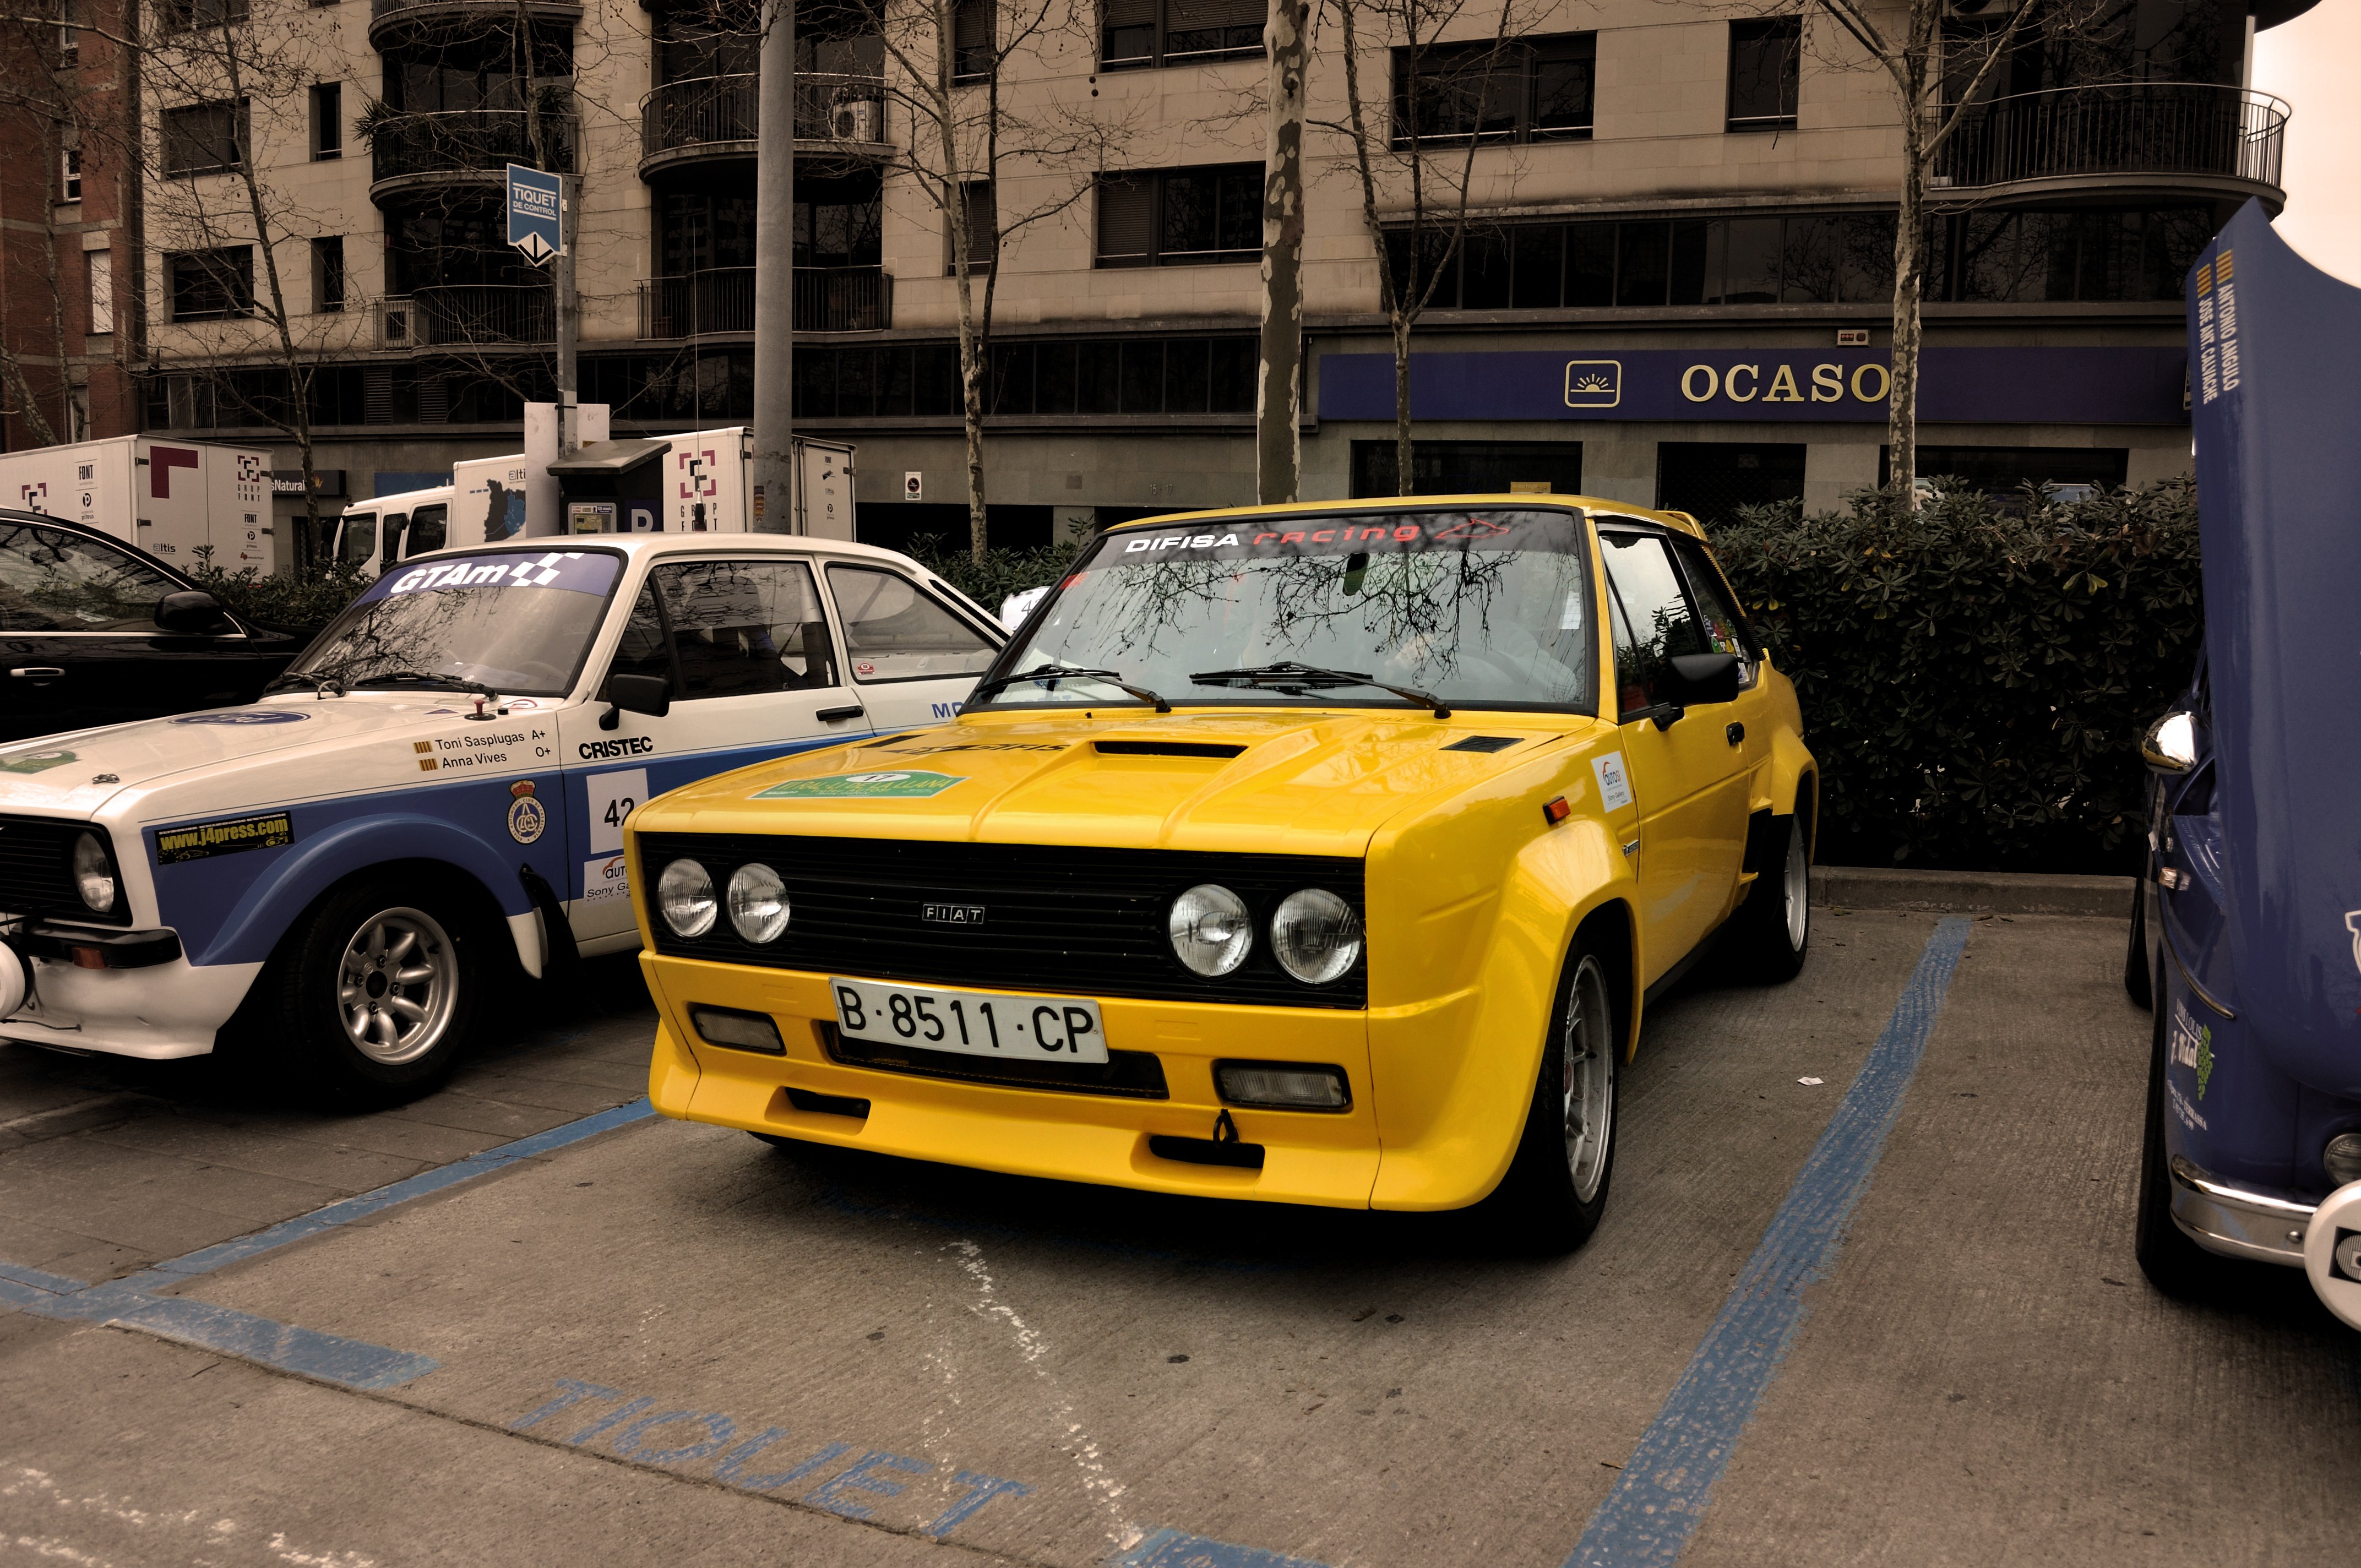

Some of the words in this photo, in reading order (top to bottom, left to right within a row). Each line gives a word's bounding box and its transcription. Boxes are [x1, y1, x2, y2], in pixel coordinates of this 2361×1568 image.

[513, 187, 556, 207] TIQUET
[524, 204, 556, 216] CONTROL
[2199, 297, 2213, 326] JOSE
[2218, 283, 2237, 340] ANTONIO
[2221, 339, 2239, 391] ANGULO
[1681, 363, 1891, 402] OCASO
[2201, 347, 2218, 405] CALVACHE
[79, 465, 94, 480] FONT
[244, 514, 257, 523] FONT
[681, 502, 717, 518] GRP
[153, 543, 176, 552] altis
[1125, 533, 1239, 553] DIFISA
[390, 563, 509, 593] GTAm
[435, 737, 463, 750] Toni
[464, 733, 525, 748] Sasplugas
[532, 729, 545, 740] A+
[579, 736, 654, 759] CRISTEC
[442, 756, 474, 768] Anna
[475, 753, 507, 765] Vives
[605, 797, 634, 827] 42
[160, 818, 289, 851] www.j4press.com
[587, 886, 614, 897] Sony
[927, 907, 981, 921] FIAT
[509, 1378, 1037, 1539] TIQUET
